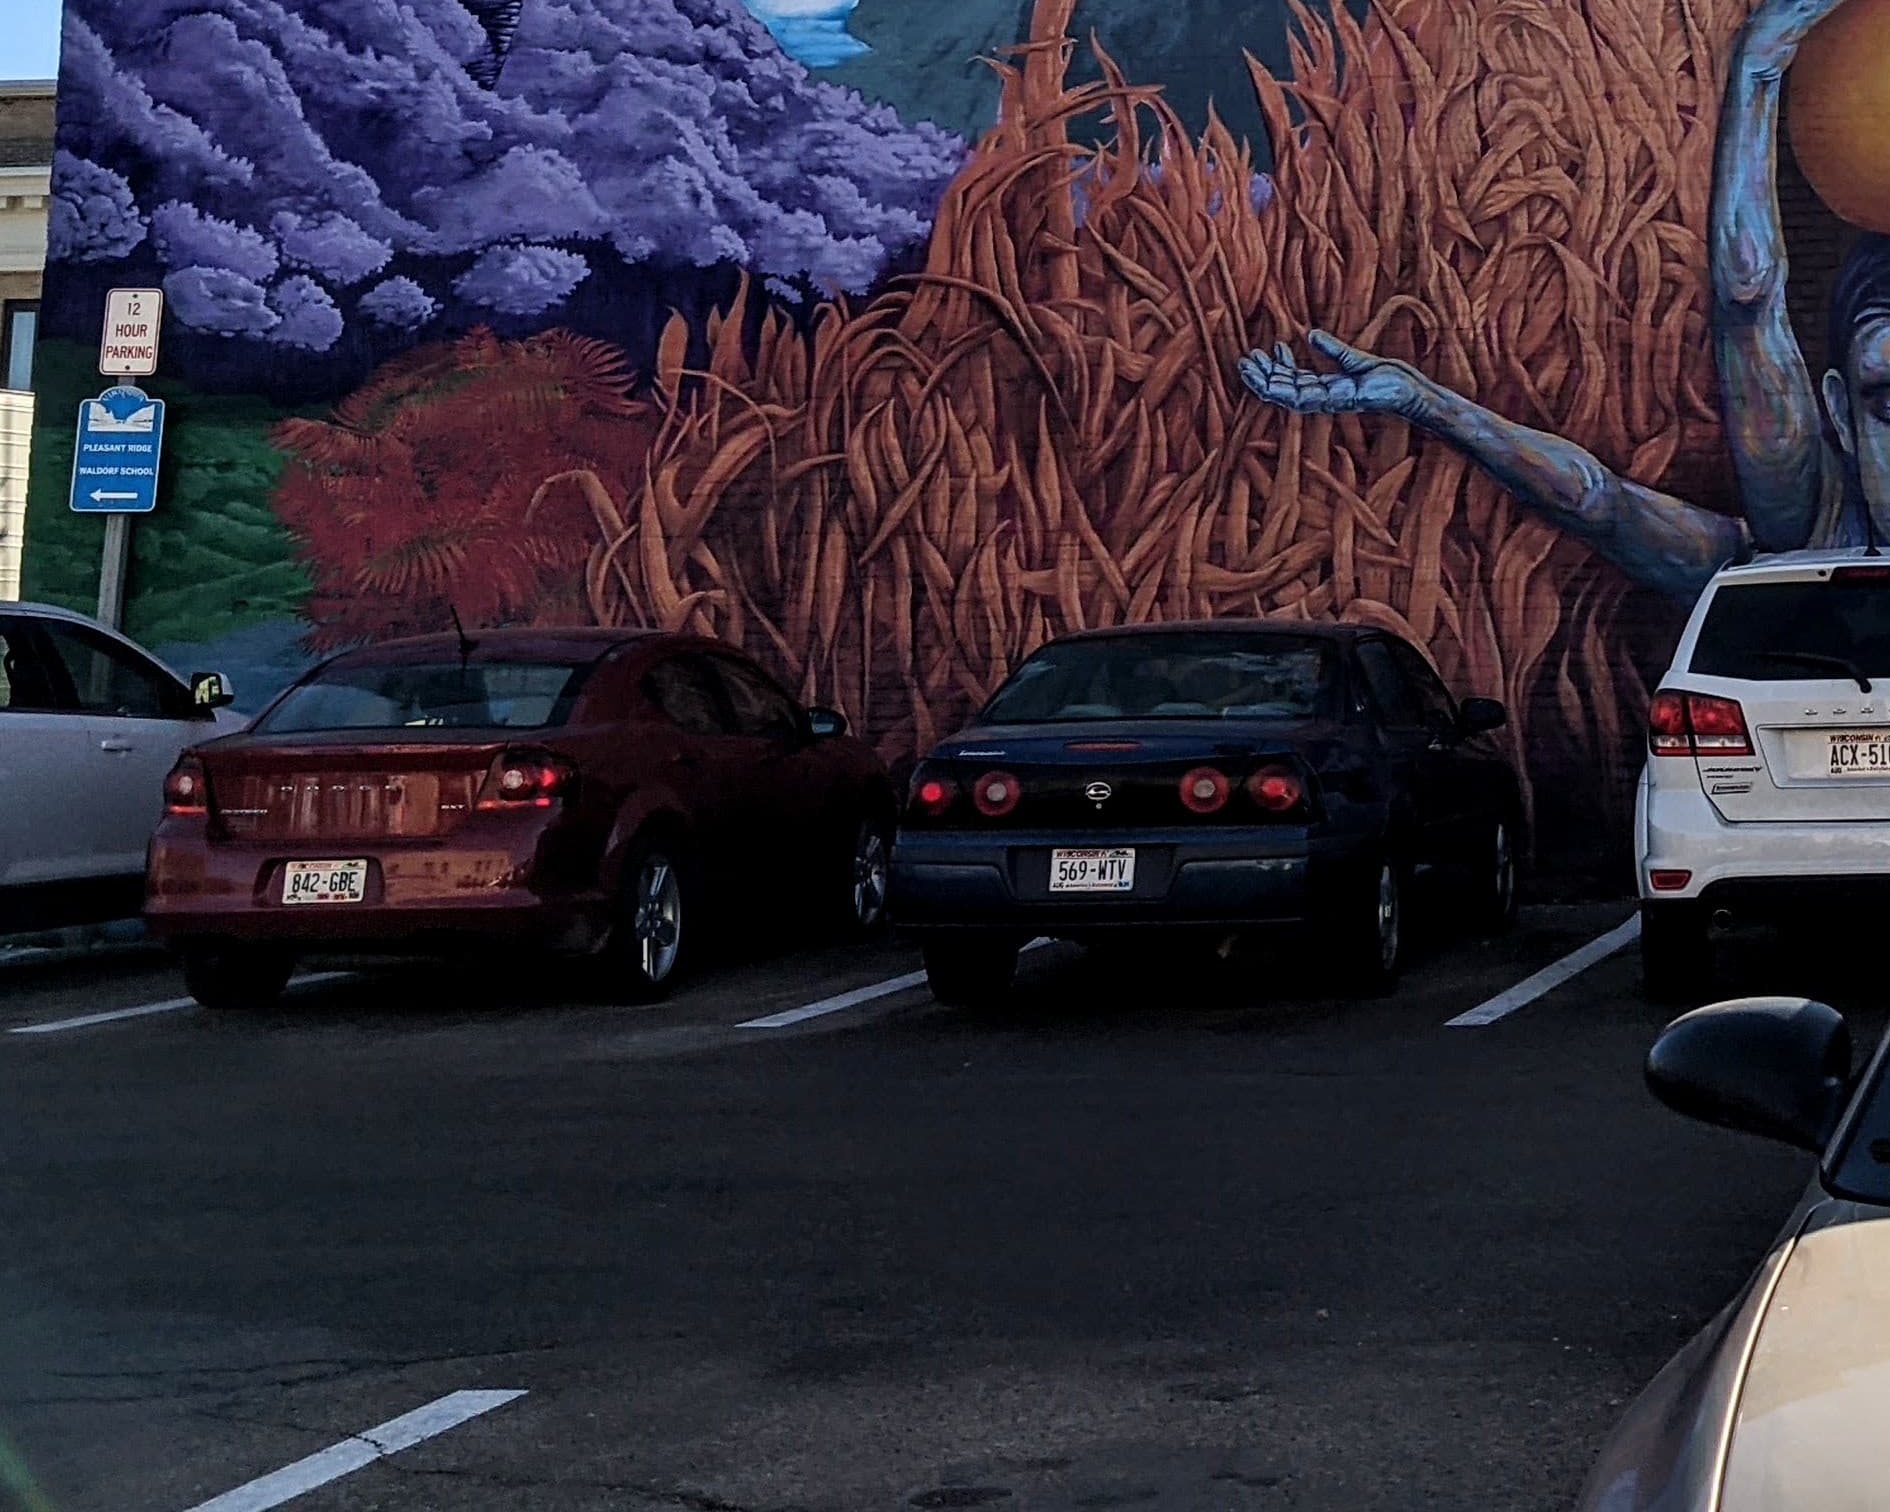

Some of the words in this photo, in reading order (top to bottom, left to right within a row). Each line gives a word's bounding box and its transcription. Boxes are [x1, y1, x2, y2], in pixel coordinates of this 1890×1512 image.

[128, 302, 141, 316] 12
[115, 323, 148, 337] HOUR
[105, 345, 153, 359] PARKING
[83, 443, 126, 452] PLEASANT
[128, 444, 153, 453] RIDGE
[79, 467, 119, 476] WALDORF
[119, 467, 154, 476] SCHOOL
[1059, 859, 1127, 881] 569-WTV
[292, 871, 358, 893] 842-GBE
